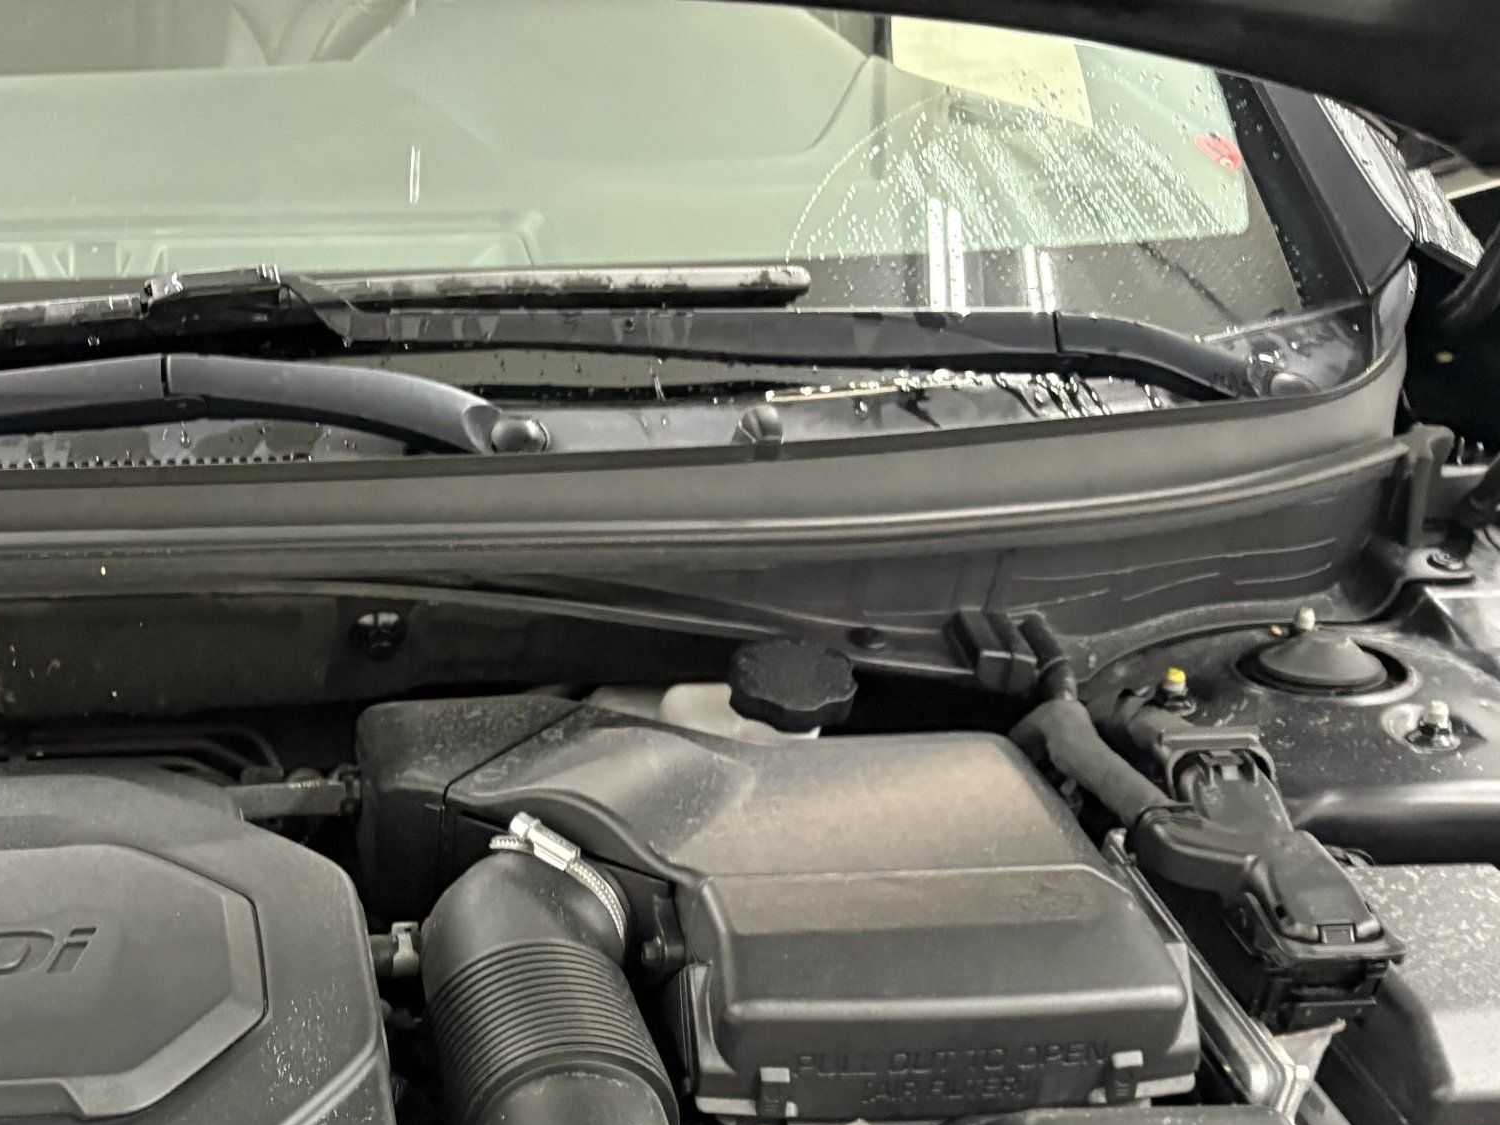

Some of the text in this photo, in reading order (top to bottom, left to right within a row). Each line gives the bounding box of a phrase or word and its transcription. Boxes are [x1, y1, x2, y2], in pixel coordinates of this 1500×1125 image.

[793, 1043, 1108, 1077] PULL OUT TO OPEN
